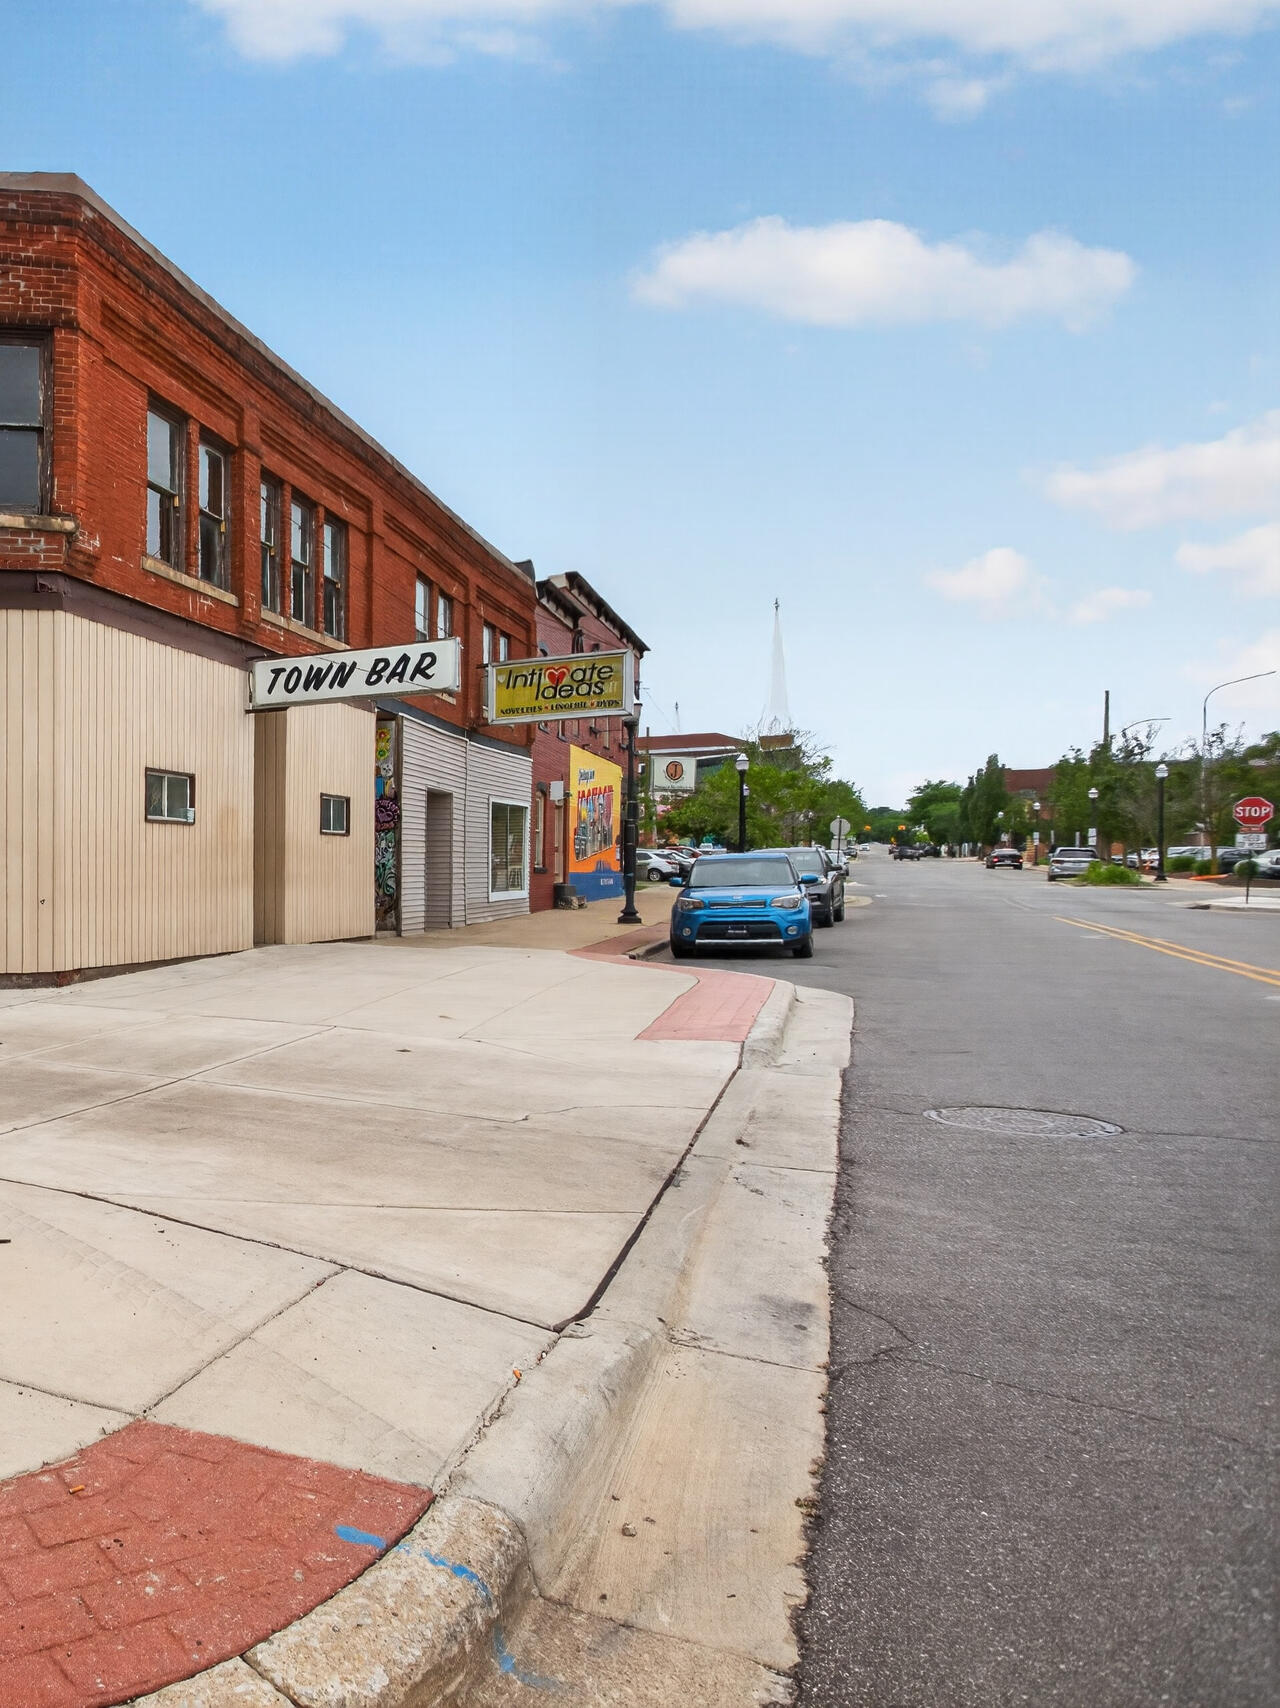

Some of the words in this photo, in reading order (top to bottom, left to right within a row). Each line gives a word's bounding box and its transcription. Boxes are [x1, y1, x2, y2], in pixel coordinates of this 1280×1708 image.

[267, 661, 358, 695] TOWN
[365, 651, 438, 687] BAR
[534, 671, 605, 701] Ideas
[1235, 806, 1271, 817] STOP
